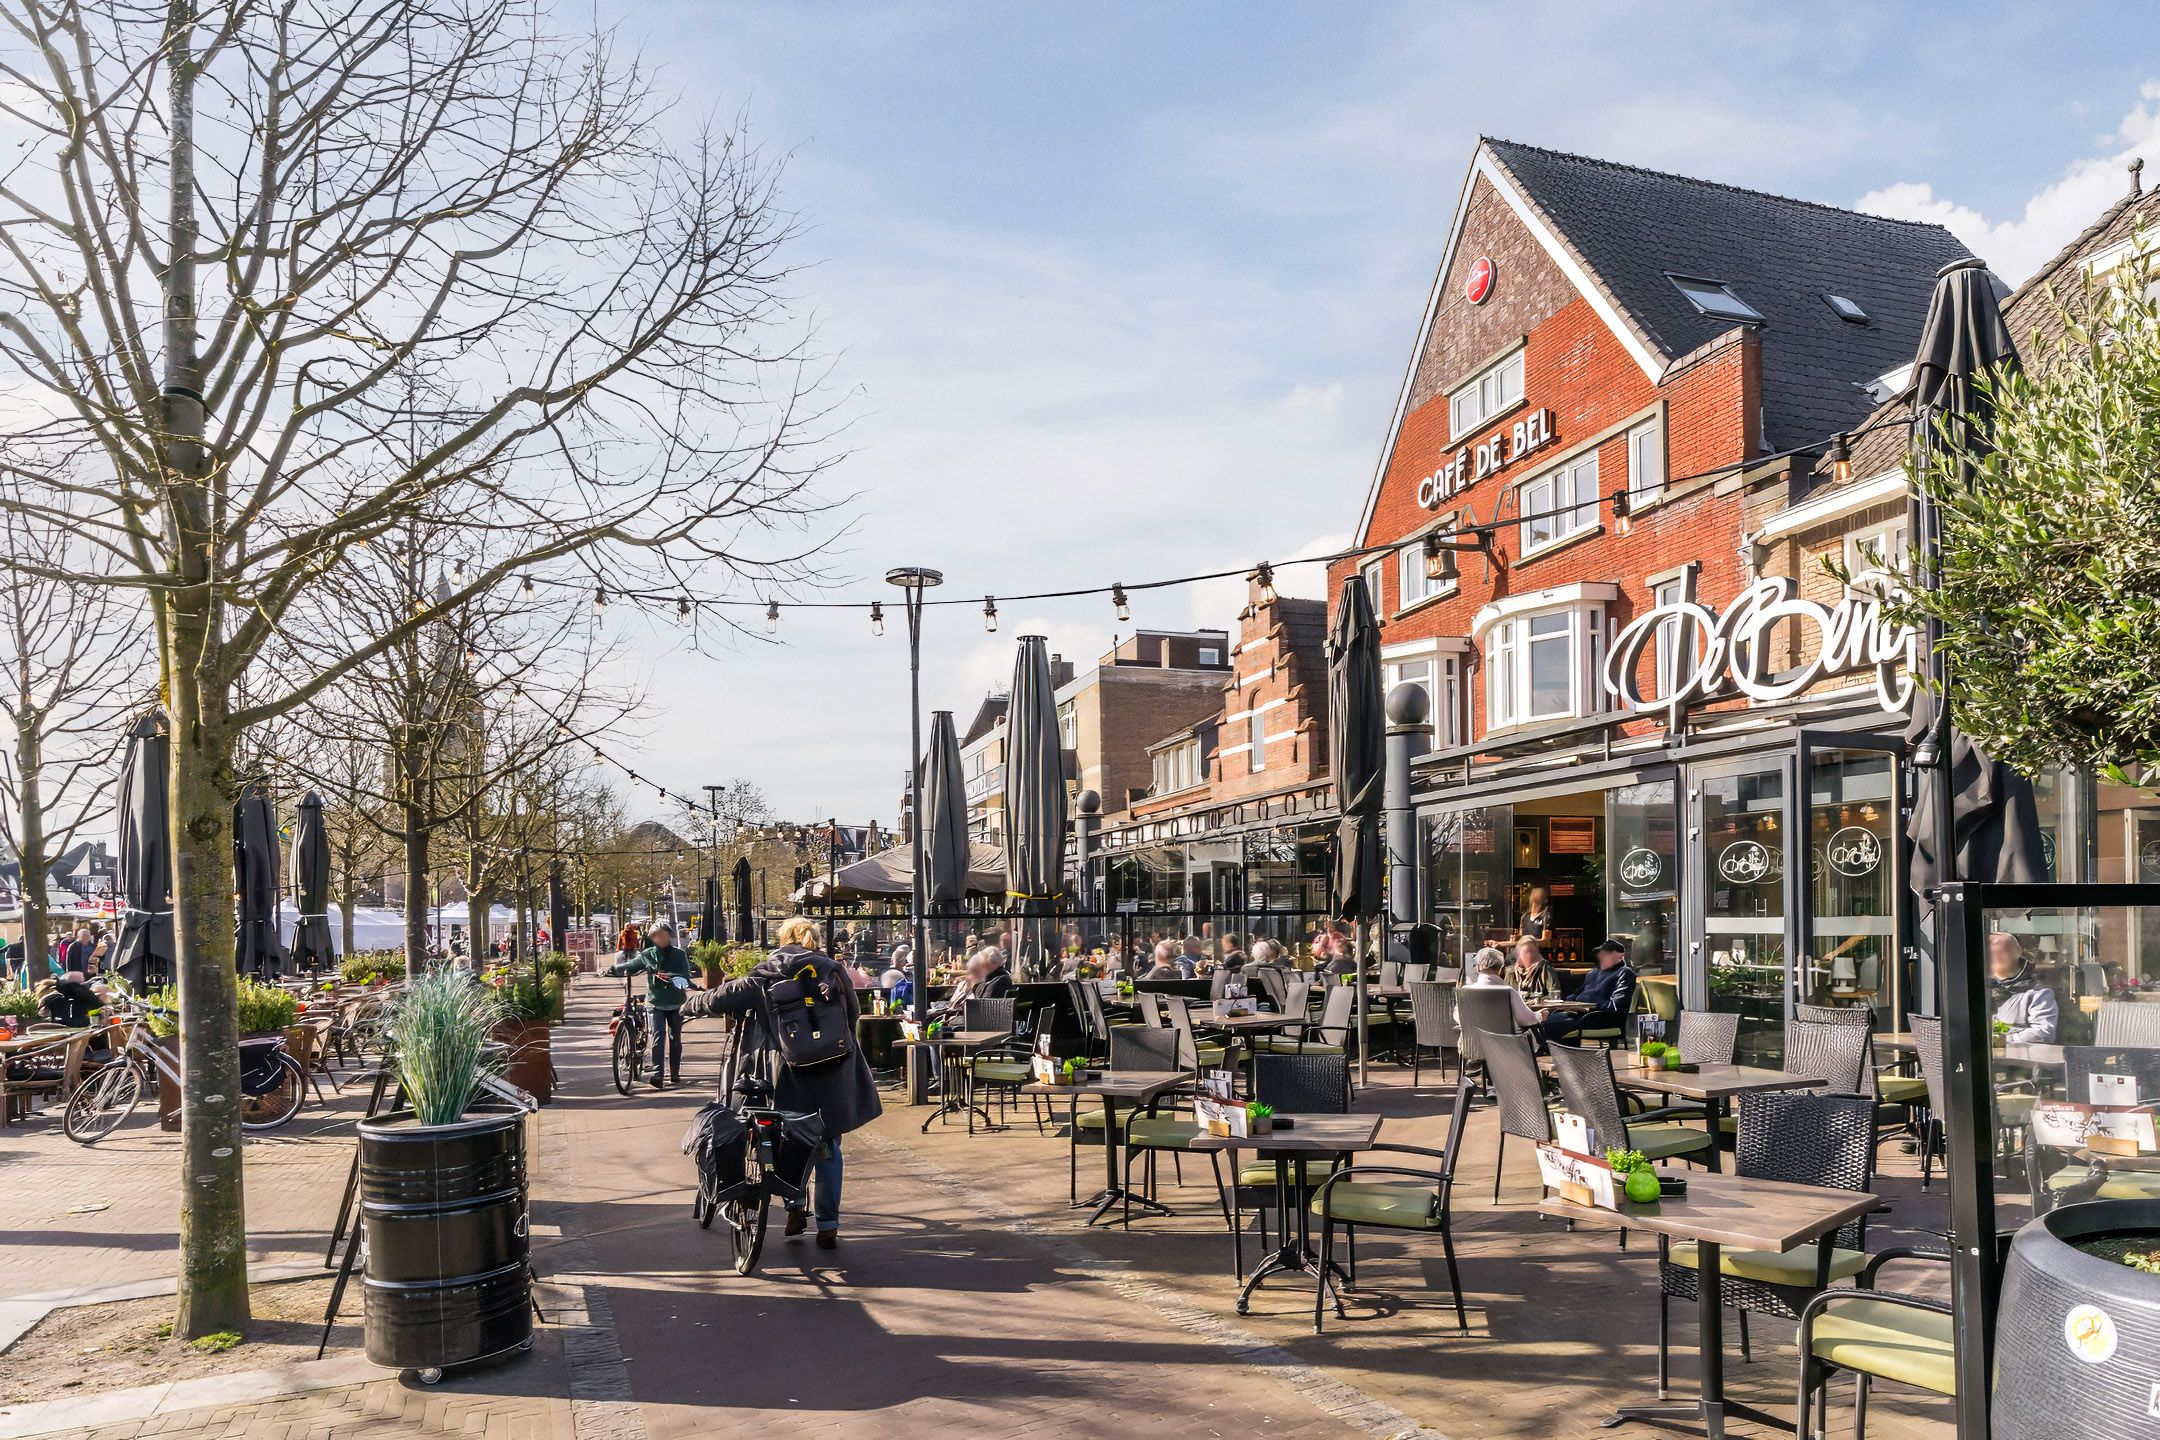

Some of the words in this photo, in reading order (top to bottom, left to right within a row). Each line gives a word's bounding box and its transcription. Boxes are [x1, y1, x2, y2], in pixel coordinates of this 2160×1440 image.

[1417, 445, 1467, 508] CAFÉ
[1475, 433, 1502, 479] DE
[1512, 407, 1551, 459] BEL
